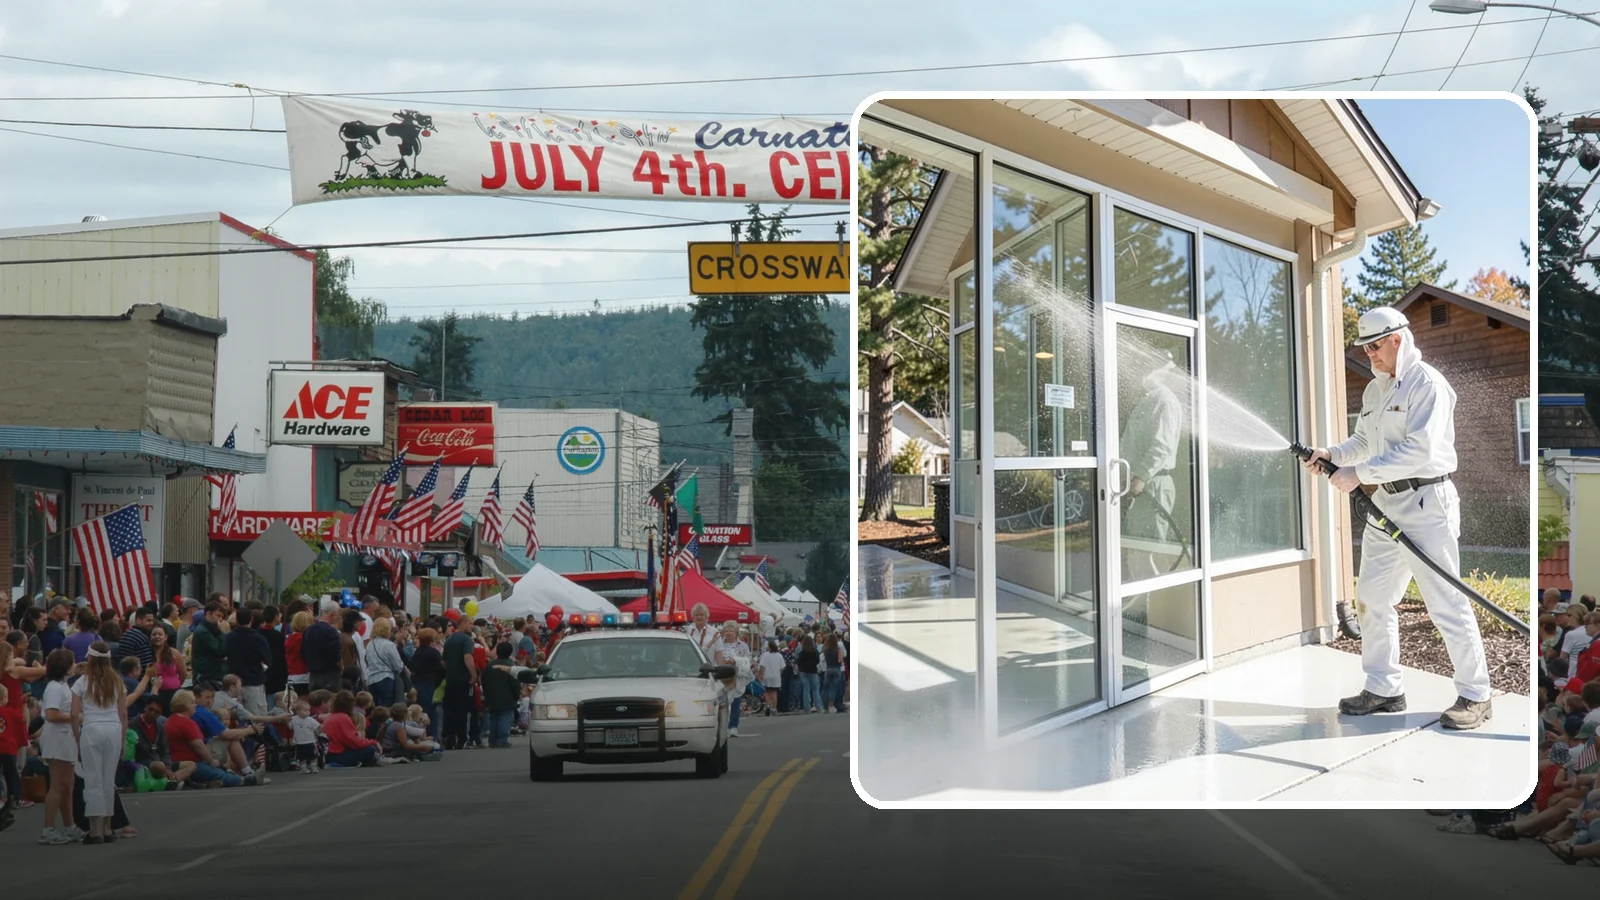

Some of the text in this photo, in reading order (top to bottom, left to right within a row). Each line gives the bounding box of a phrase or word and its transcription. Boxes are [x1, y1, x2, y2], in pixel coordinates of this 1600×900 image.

[481, 140, 605, 193] JULY
[632, 150, 747, 197] 4th.
[697, 254, 850, 280] CROSSWA
[282, 380, 374, 420] ACE
[405, 409, 452, 422] CEDAR
[283, 421, 371, 436] Hardware
[416, 427, 477, 447] Coca-Cola
[353, 467, 386, 481] Simpl
[96, 485, 124, 495] Vincent
[126, 486, 136, 495] de
[137, 486, 155, 495] Paul
[699, 535, 730, 543] GLASS
